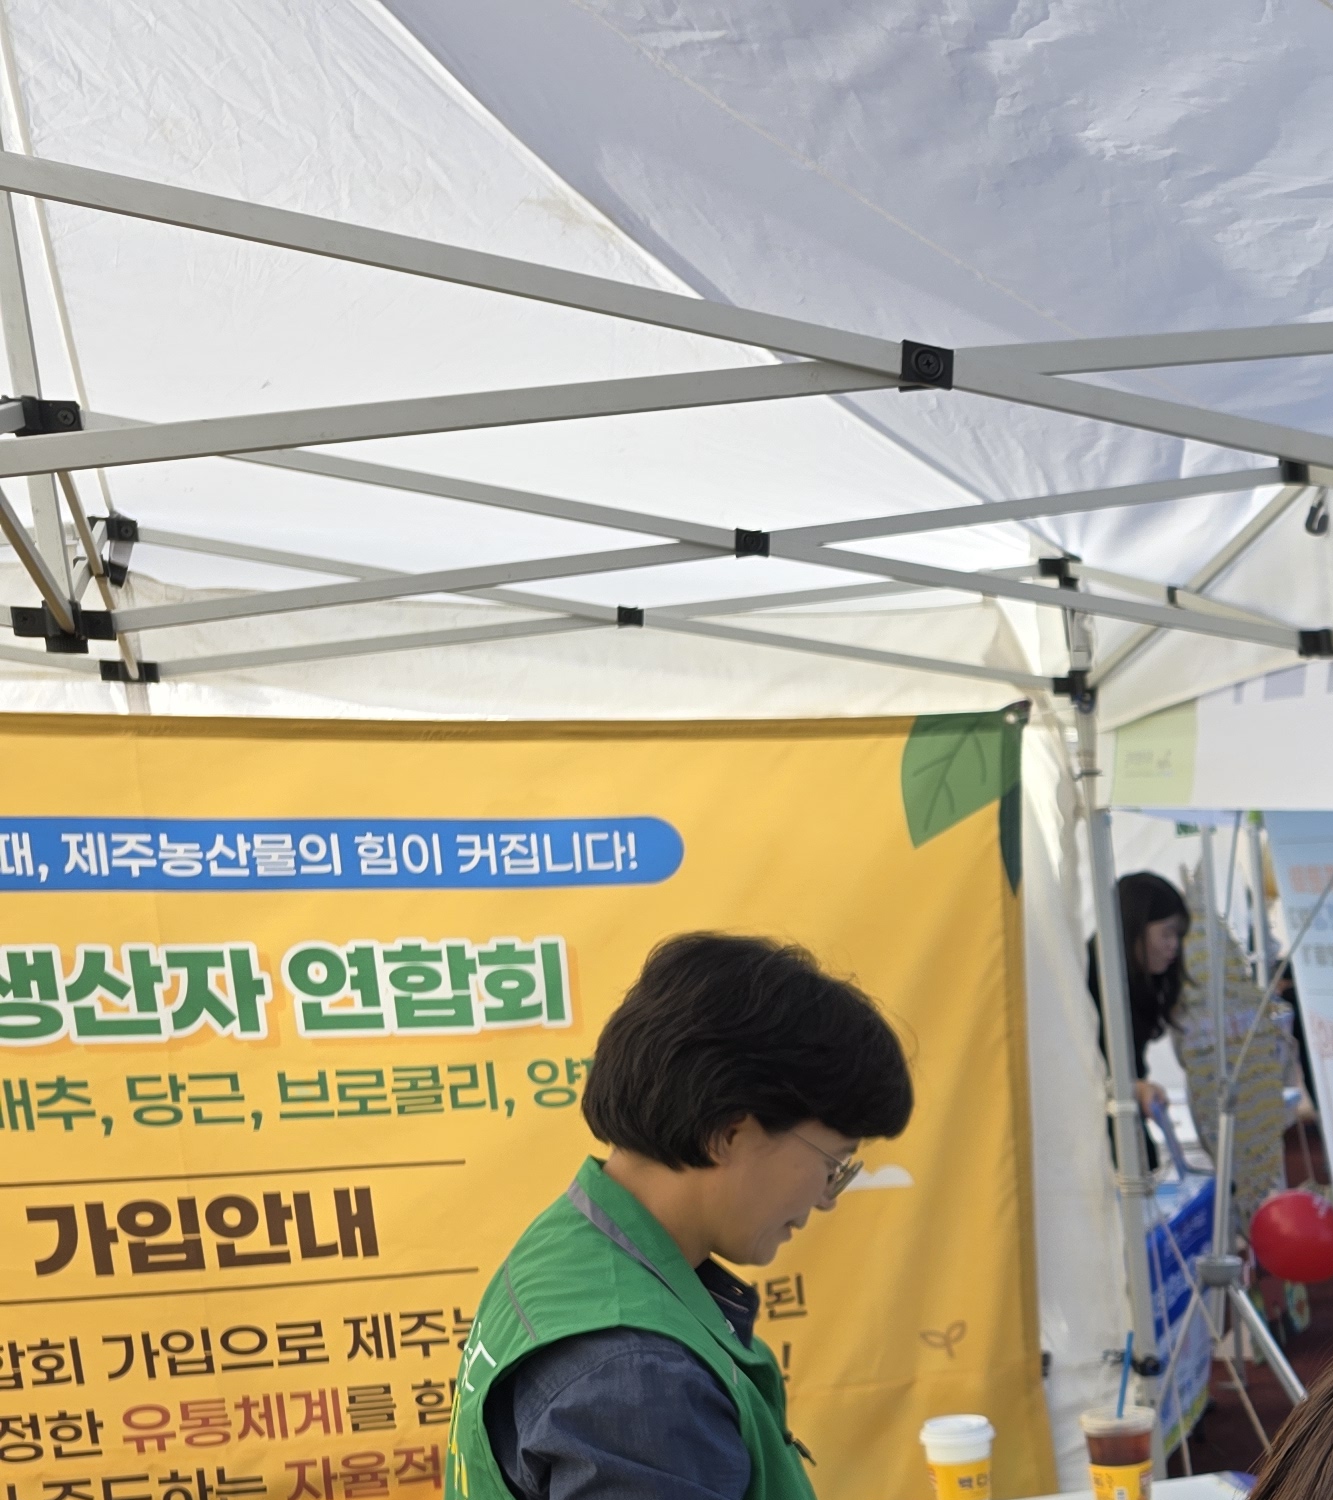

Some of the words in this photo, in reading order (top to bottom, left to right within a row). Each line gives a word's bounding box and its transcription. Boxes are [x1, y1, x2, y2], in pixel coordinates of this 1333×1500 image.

[61, 830, 342, 879] 제주농산물의
[353, 831, 442, 876] 힘이
[455, 830, 639, 876] 커집니다!
[0, 942, 270, 1044] 생산자
[283, 936, 570, 1036] 연합회
[126, 1069, 263, 1132] 당근,
[278, 1060, 516, 1120] 브로콜리,
[526, 1056, 594, 1110] 양
[26, 1186, 380, 1278] 가입안내
[103, 1320, 329, 1381] 가입으로
[122, 1384, 397, 1455] 유통체계를
